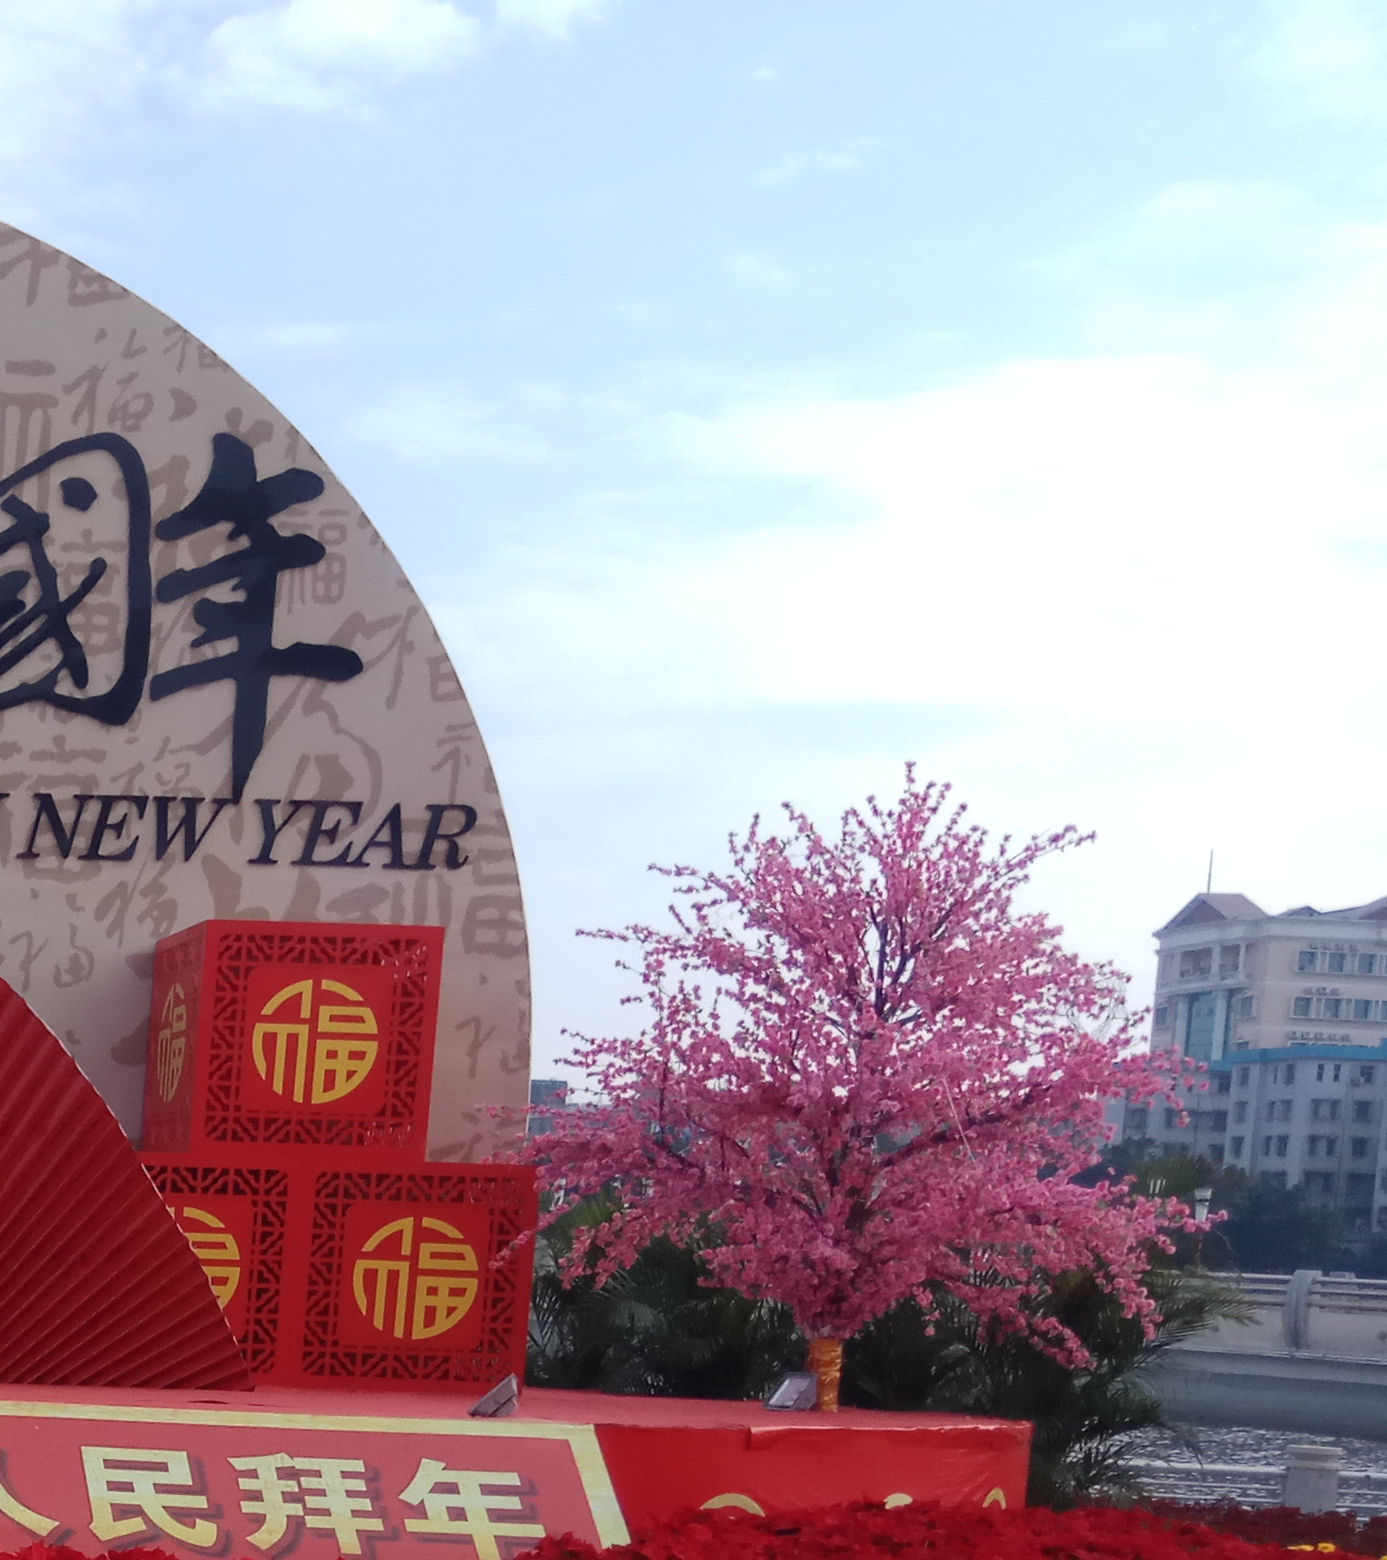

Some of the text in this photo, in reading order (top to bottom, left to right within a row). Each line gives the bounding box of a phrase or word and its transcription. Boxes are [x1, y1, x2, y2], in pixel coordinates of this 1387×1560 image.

[16, 792, 236, 862] NEW
[248, 798, 477, 870] YEAR
[252, 979, 379, 1104] 福
[353, 1217, 479, 1340] 福
